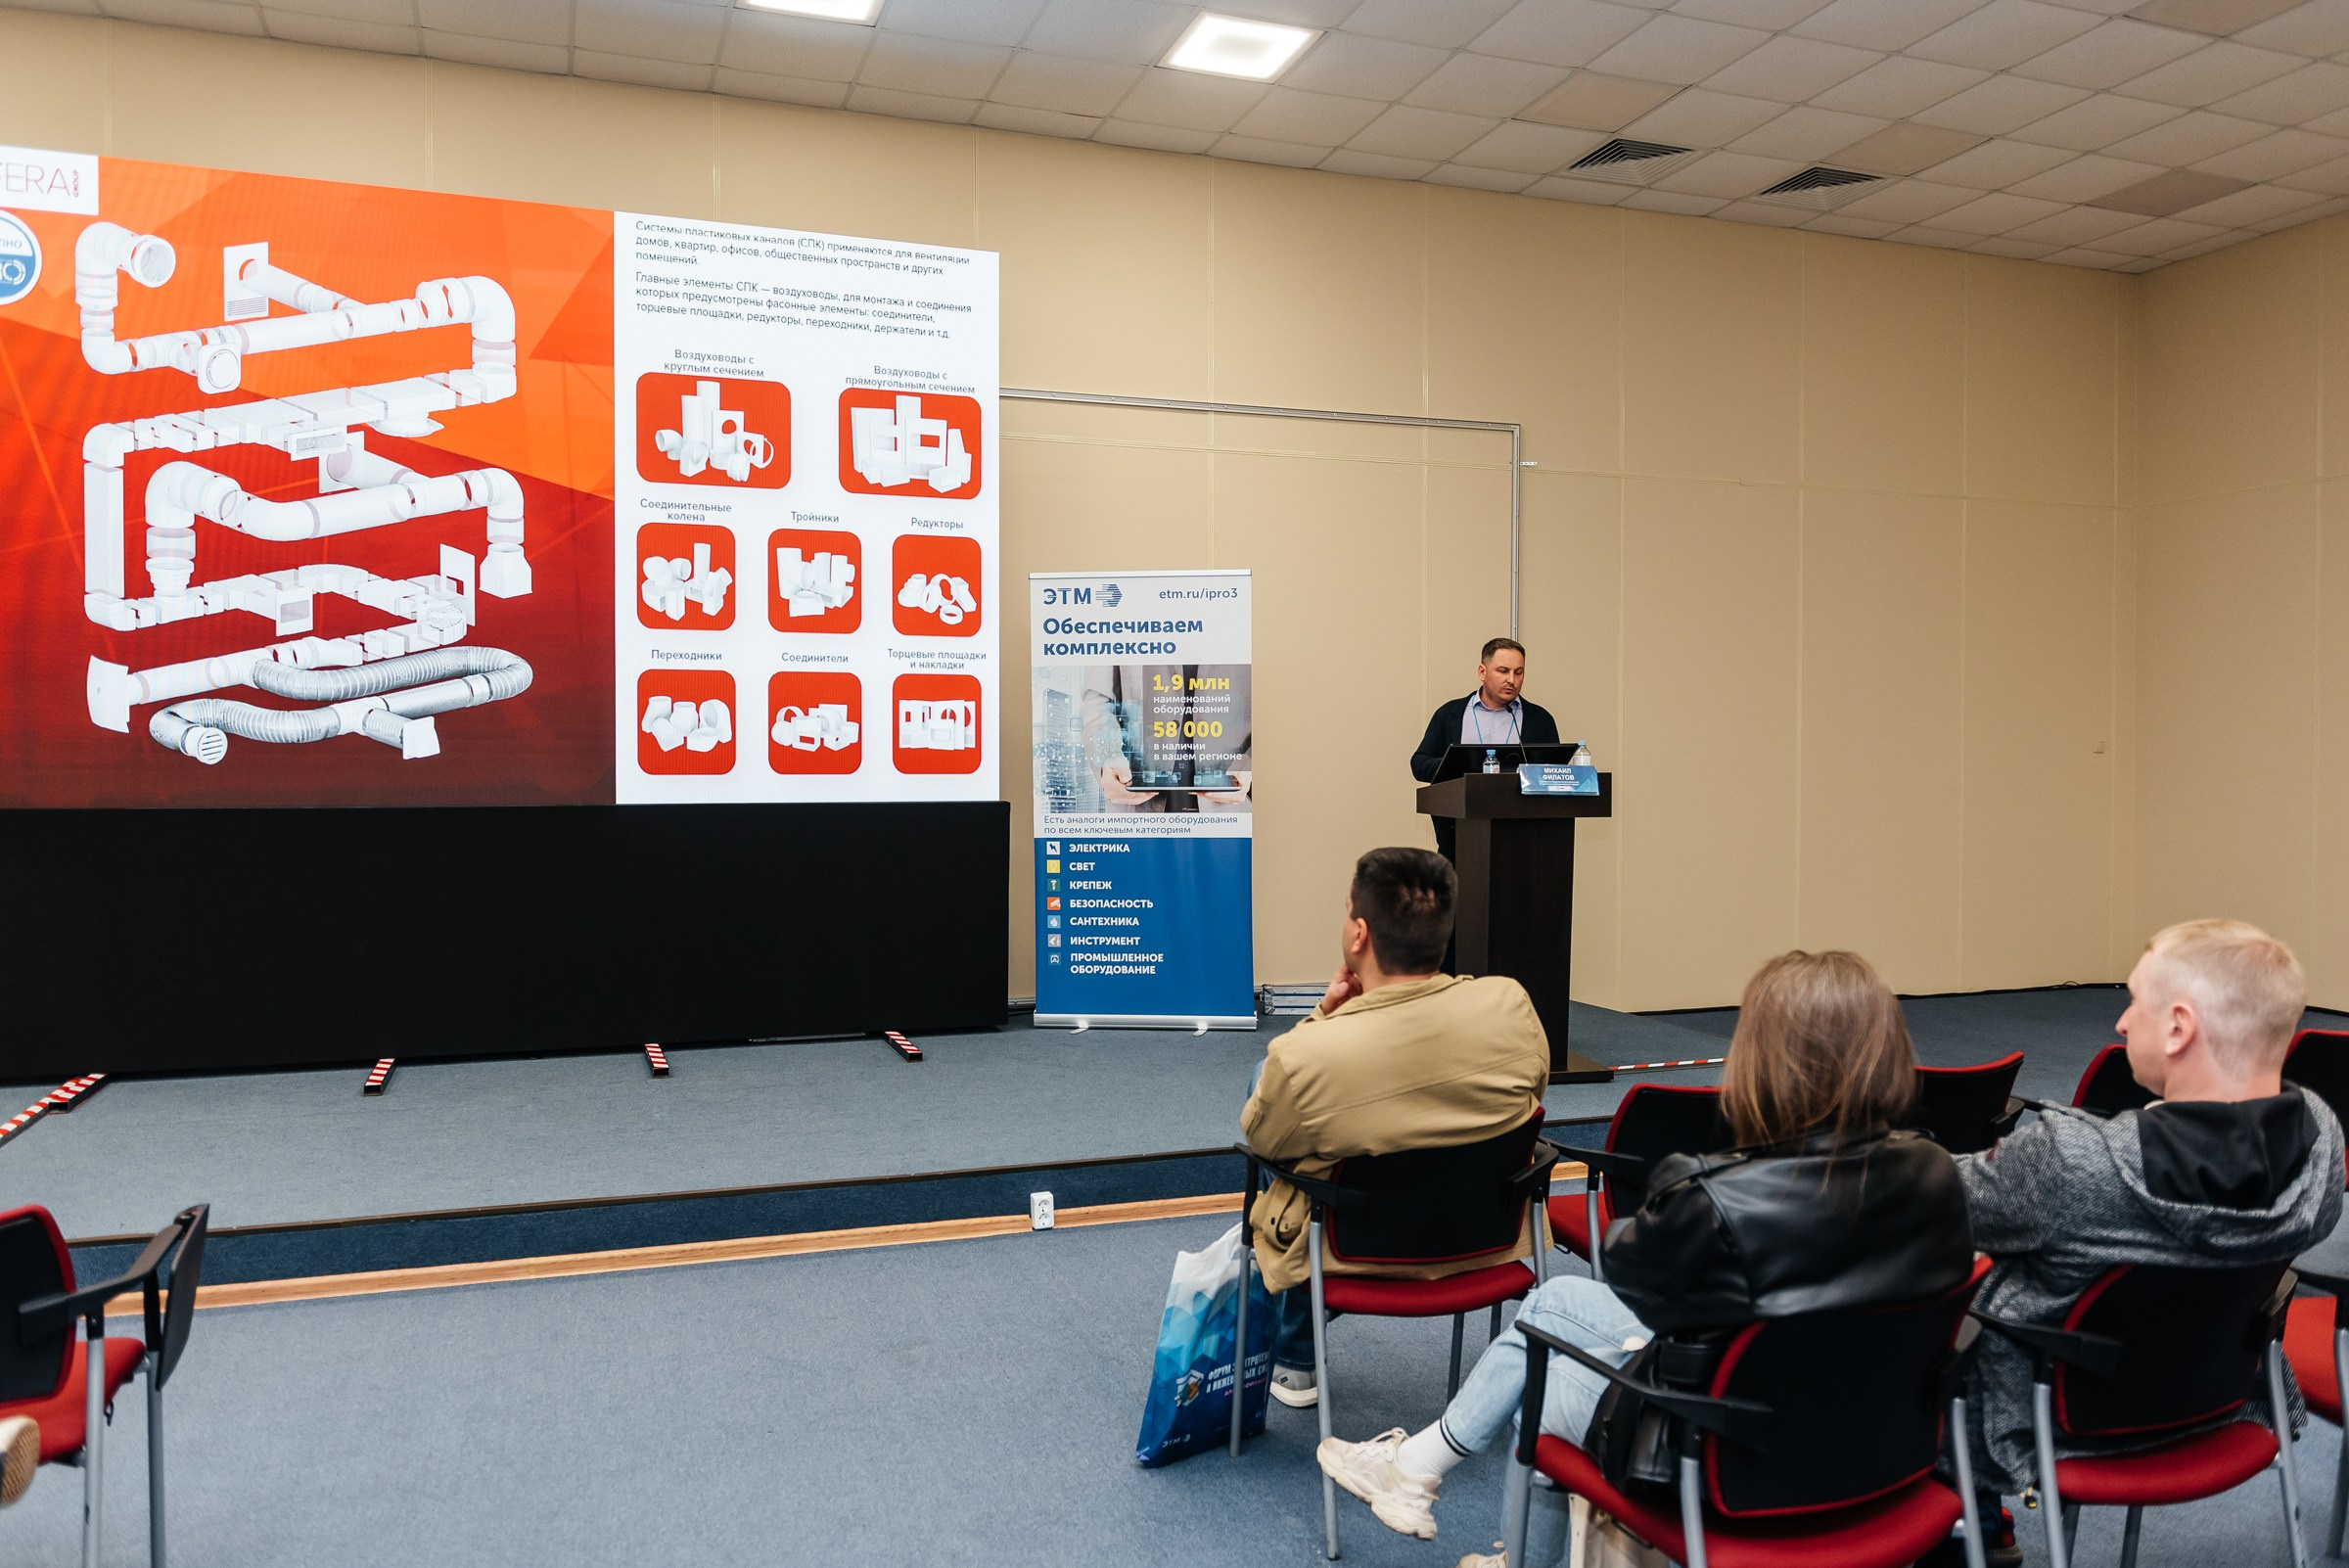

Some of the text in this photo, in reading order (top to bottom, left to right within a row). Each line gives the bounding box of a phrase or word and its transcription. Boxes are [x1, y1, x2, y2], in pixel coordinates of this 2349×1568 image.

[636, 221, 682, 234] Системы
[685, 227, 750, 242] пластиковых
[754, 235, 795, 246] каналов
[798, 238, 825, 251] (СПК)
[827, 243, 892, 256] применяются
[915, 252, 970, 264] вентиляции
[636, 237, 672, 249] домов,
[674, 240, 718, 254] квартир,
[721, 245, 762, 257] офисов,
[764, 249, 838, 264] общественных
[841, 256, 900, 271] пространств
[911, 265, 944, 275] других
[636, 252, 700, 265] помещений.
[636, 271, 680, 285] Главные
[683, 278, 734, 291] элементы
[736, 282, 759, 293] СПК
[772, 287, 841, 301] воздуховоды,
[843, 294, 861, 302] для
[863, 296, 905, 306] монтажа
[915, 300, 972, 313] соединения
[636, 288, 936, 323] которых предусмотрены фасонные элементы: соединители,
[636, 302, 687, 315] торцевые
[690, 307, 744, 321] площадки,
[747, 312, 804, 326] редукторы,
[806, 317, 872, 333] переходники,
[874, 324, 926, 336] держатели
[937, 330, 950, 339] т.д.
[674, 349, 745, 365] Воздуховоды
[664, 361, 764, 378] круглым сечением
[874, 365, 940, 380] Воздуховоды
[845, 376, 975, 393] прямоугольным сечением
[640, 498, 732, 512] Соединительные
[668, 511, 706, 521] колена
[791, 511, 840, 524] Тройники
[910, 517, 964, 530] Редукторы
[1043, 587, 1091, 605] ЭТМ
[1159, 587, 1238, 601] etm.ru/ipro3
[1043, 617, 1203, 635] Обеспечиваем
[888, 648, 987, 662] Торцевые площадки
[1043, 641, 1176, 656] комплексно
[651, 649, 722, 663] Переходники
[781, 652, 849, 664] Соединители
[919, 661, 965, 670] накладки
[1153, 674, 1230, 693] 1,9 млн
[1153, 694, 1231, 704] наименований
[1153, 705, 1229, 715] оборудования
[1153, 720, 1222, 738] 58 000
[1199, 753, 1242, 762] регионе
[1044, 815, 1064, 824] Есть
[1107, 816, 1166, 826] импортного
[1168, 815, 1238, 826] оборудования
[1135, 826, 1191, 835] категориям
[1069, 844, 1130, 853] ЭЛЕКТРИКА
[1069, 862, 1095, 871] СВЕТ
[1069, 881, 1112, 890] КРЕПЕЖ
[1069, 899, 1154, 908] БЕЗОПАСНОСТЬ
[1070, 917, 1139, 926] САНТЕХНИКА
[1070, 937, 1140, 945] ИНСТРУМЕНТ
[1070, 953, 1164, 962] ПРОМЫШЛЕННОЕ
[1070, 965, 1156, 976] ОБОРУДОВАНИЕ
[1208, 1363, 1231, 1381] ФОРУМ
